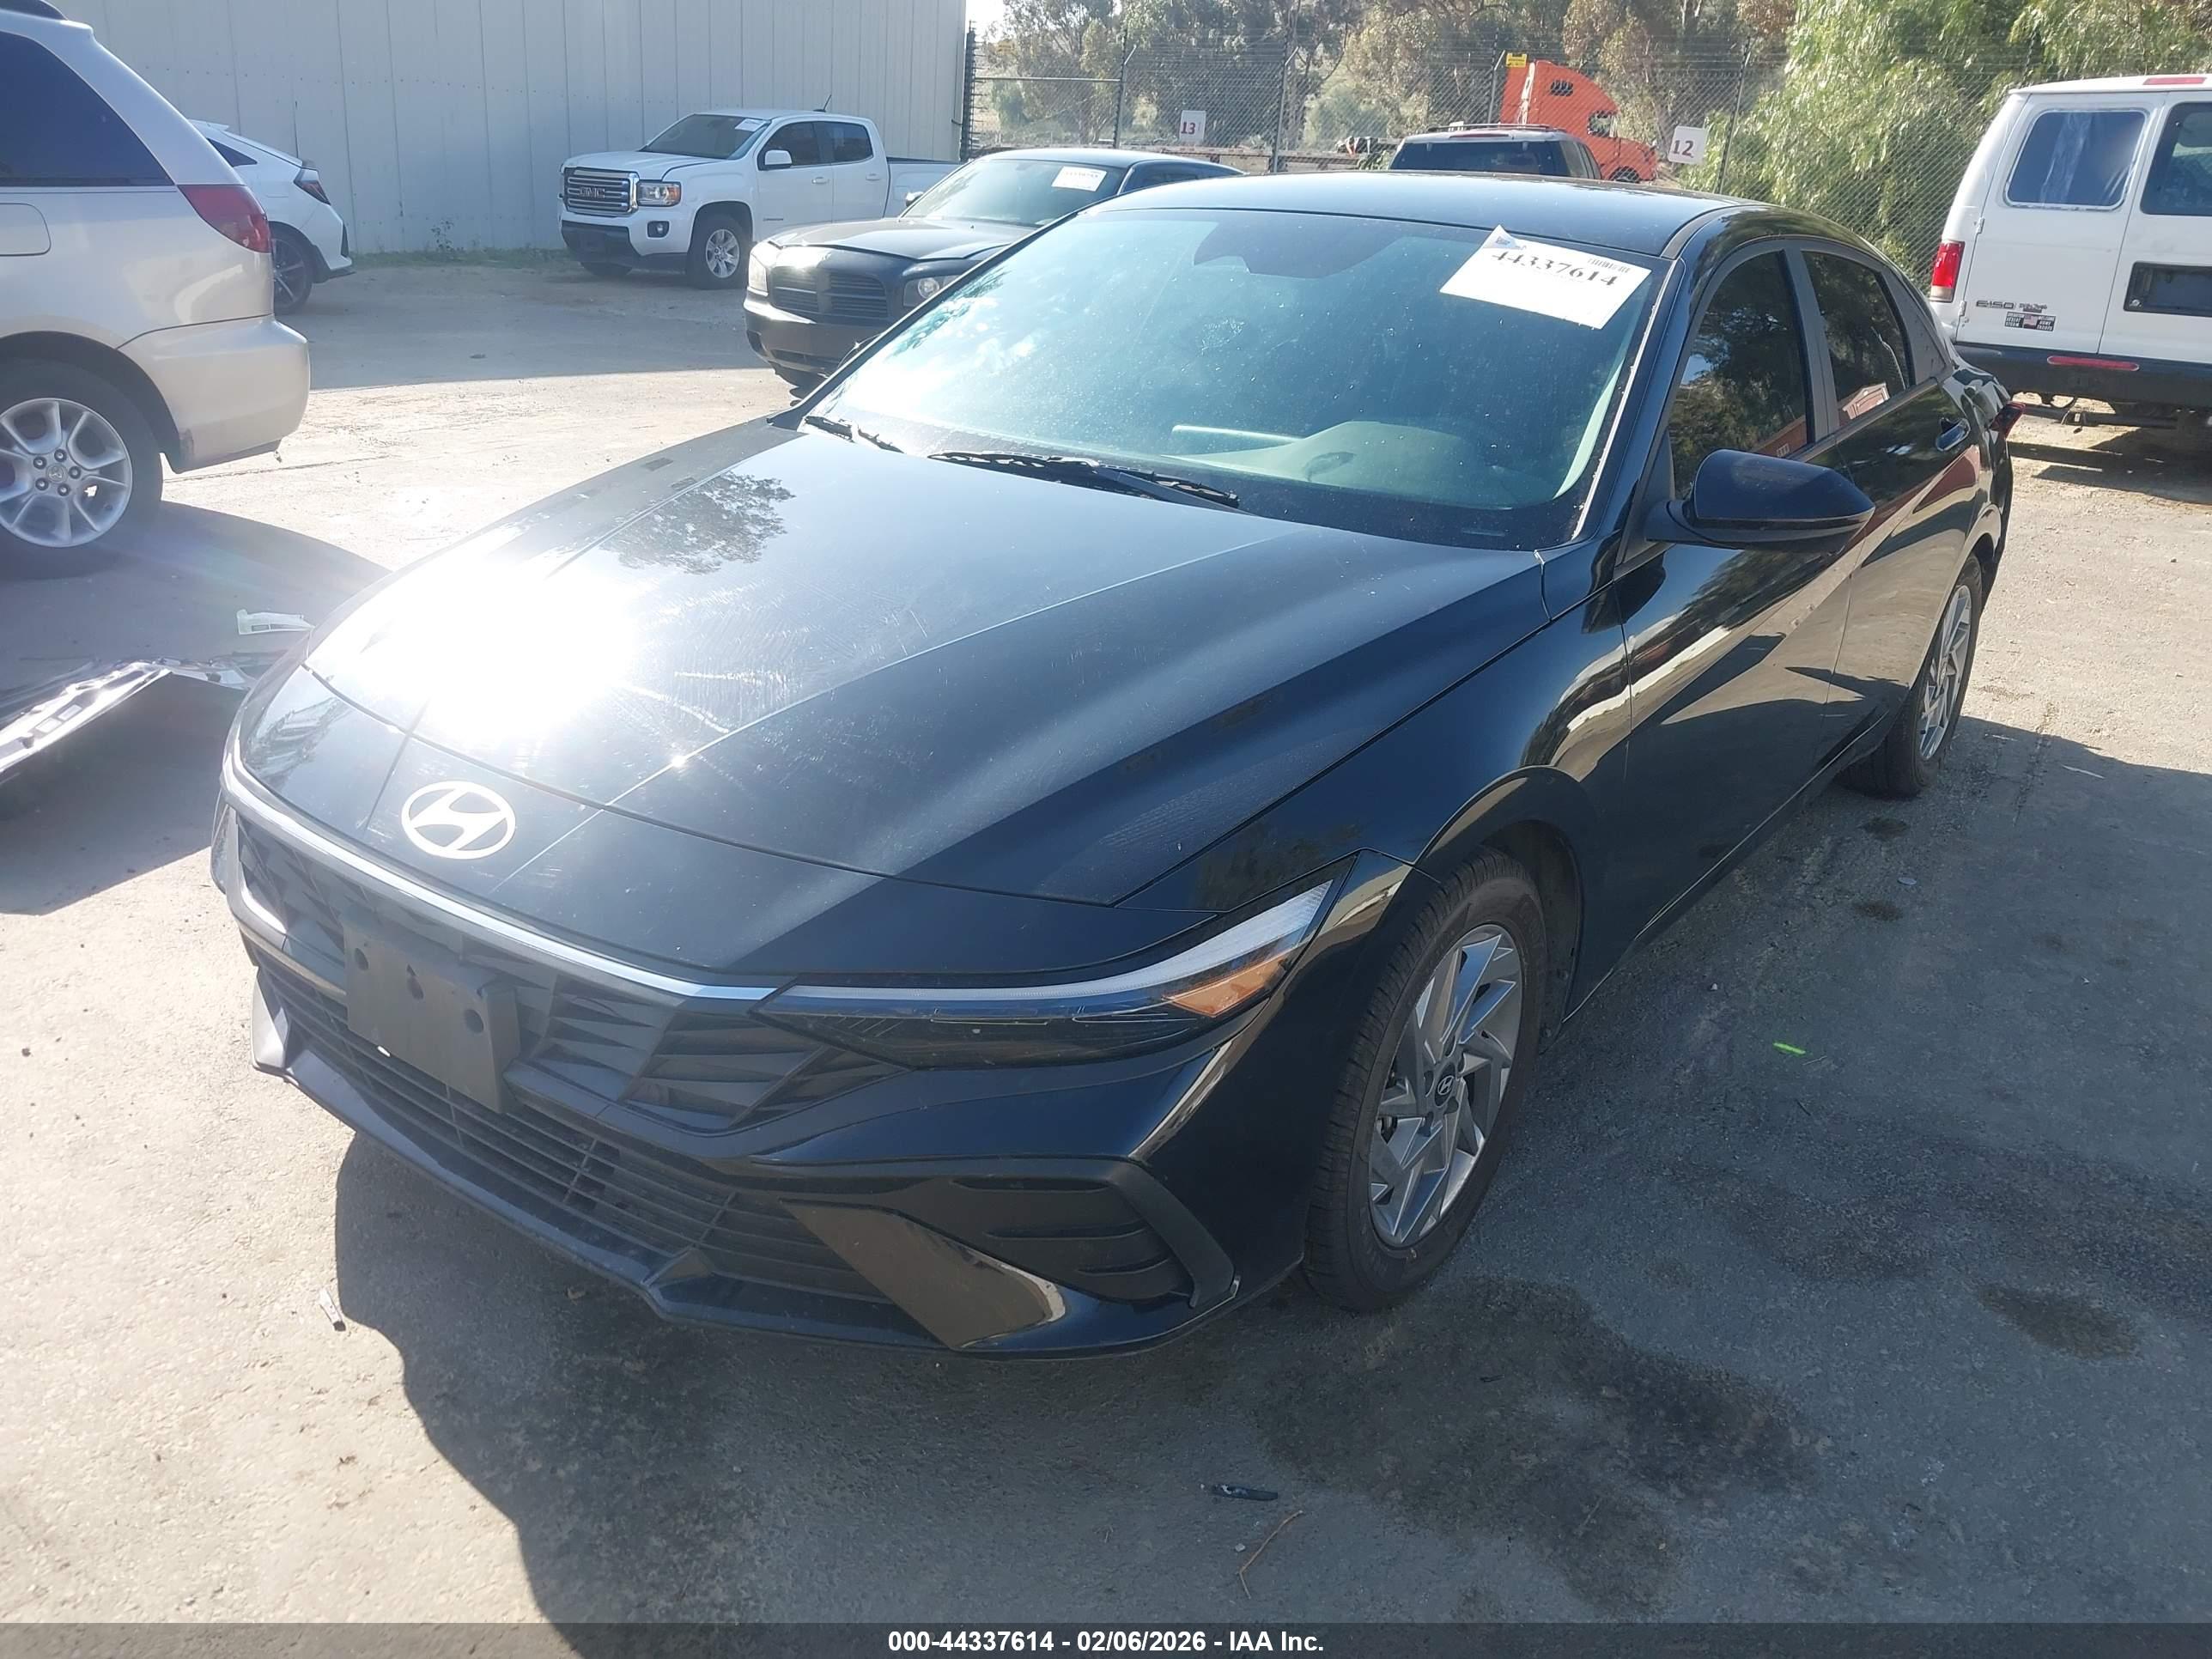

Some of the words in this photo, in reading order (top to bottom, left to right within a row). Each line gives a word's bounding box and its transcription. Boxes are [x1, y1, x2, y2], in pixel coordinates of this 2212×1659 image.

[1181, 121, 1196, 135] 13
[1673, 140, 1694, 158] 12
[579, 186, 605, 198] GMC
[1492, 251, 1619, 286] 44337614
